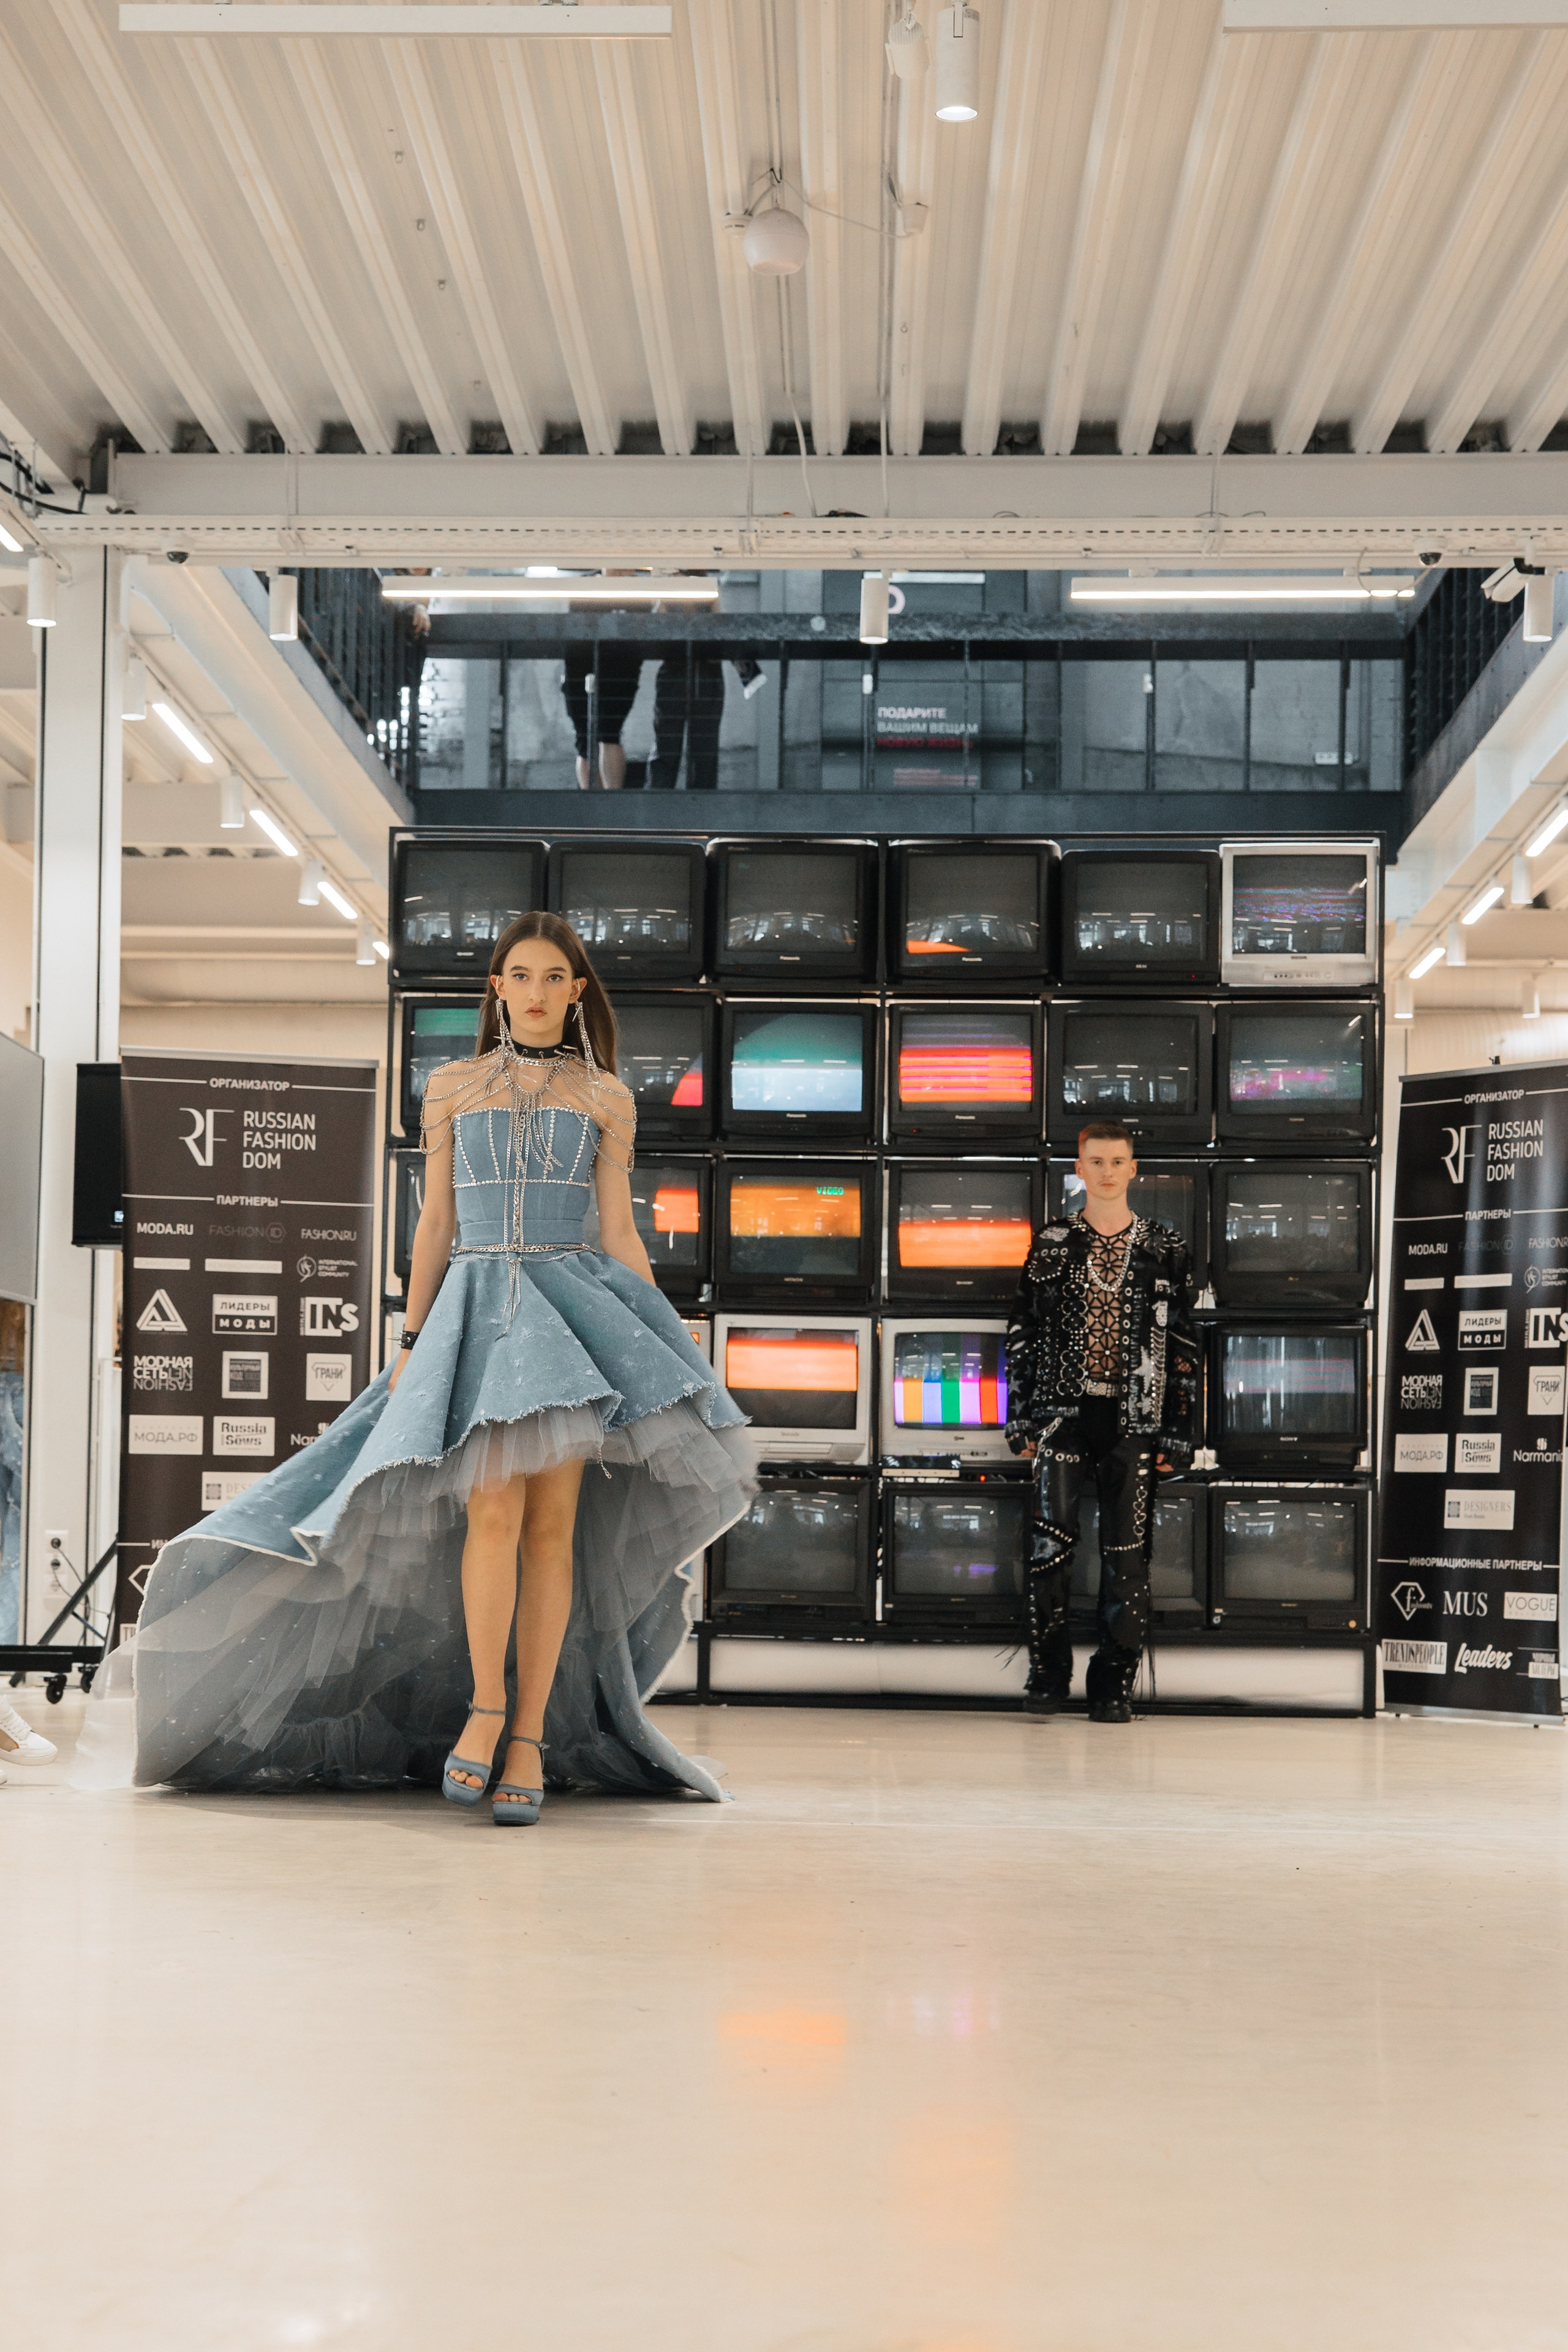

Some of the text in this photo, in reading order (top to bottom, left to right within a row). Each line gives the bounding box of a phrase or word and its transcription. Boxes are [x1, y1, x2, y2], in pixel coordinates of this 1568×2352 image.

[877, 707, 947, 719] ПОДАРИТЕ
[876, 721, 927, 733] ВАШИМ
[209, 1077, 290, 1091] ОРГАНИЗАТОР
[1464, 1089, 1525, 1104] ОРГАНИЗАТОР
[244, 1110, 316, 1131] RUSSIAN
[1488, 1119, 1544, 1140] RUSSIAN
[243, 1131, 317, 1151] FASHION
[1487, 1140, 1544, 1161] FASHION
[243, 1152, 282, 1170] DOM
[1487, 1163, 1515, 1182] DOM
[216, 1194, 279, 1207] ПАРТНЕРЫ
[1465, 1208, 1512, 1221] ПАРТНЕРЫ
[137, 1222, 194, 1235] MODA.RU
[1408, 1243, 1448, 1256] MODA.RU
[220, 1301, 270, 1311] ЛИДЕРЫ
[219, 1318, 271, 1330] МОДЫ
[1464, 1317, 1501, 1327] ЛИДЕРЫ
[1463, 1334, 1501, 1344] МОДЫ
[133, 1366, 168, 1379] СЕТЬ
[315, 1367, 343, 1379] ГРАНИ
[1401, 1386, 1427, 1399] СЕТЬ
[1536, 1381, 1559, 1392] ГРАНИ
[221, 1422, 267, 1434] Russia
[134, 1431, 198, 1444] МОДА.РФ
[1461, 1439, 1496, 1450] Russia
[1400, 1450, 1444, 1462] МОДА.РФ
[1463, 1501, 1512, 1513] DESIGNERS
[1409, 1557, 1542, 1571] ИНФОРМАЦИОННЫЕ ПАРТНЕРЫ
[1442, 1591, 1488, 1617] MUS
[1506, 1596, 1556, 1612] VOGUE
[1454, 1643, 1513, 1674] Leaders
